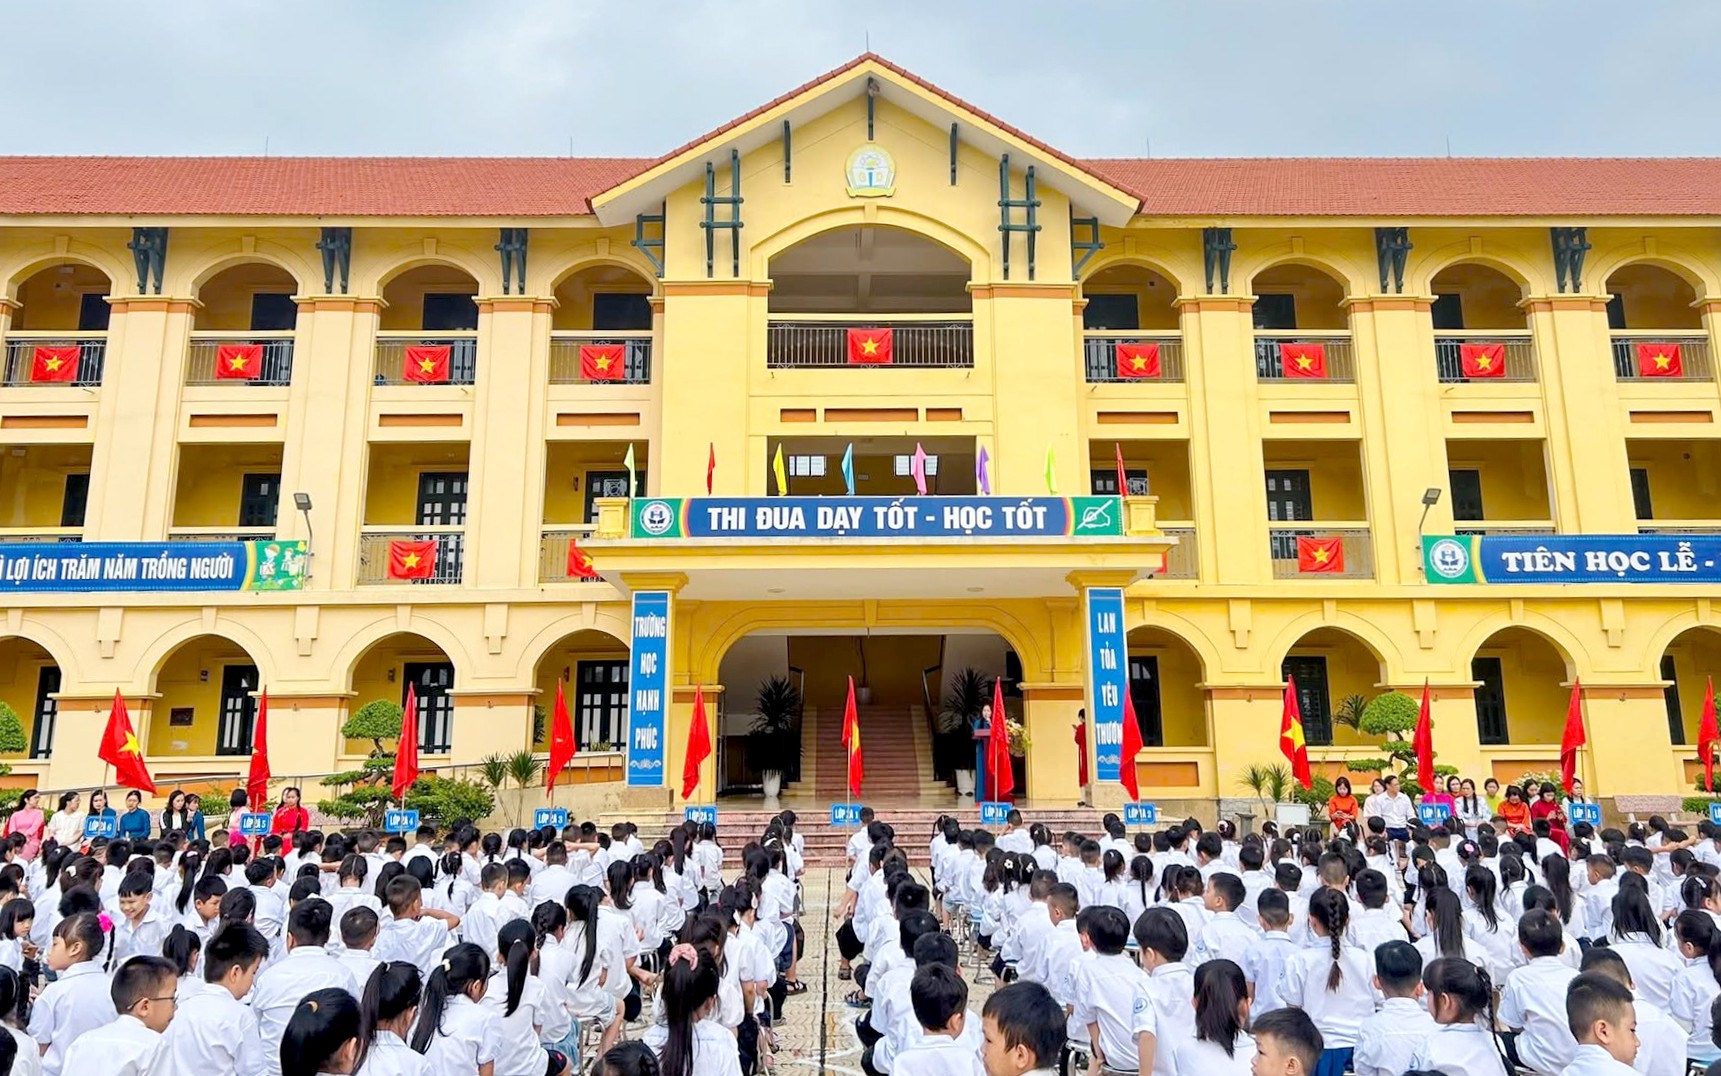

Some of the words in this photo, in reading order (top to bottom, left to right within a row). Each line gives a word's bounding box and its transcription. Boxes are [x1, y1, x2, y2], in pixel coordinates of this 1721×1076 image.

[707, 507, 746, 530] THI
[756, 507, 806, 530] ĐUA
[817, 507, 863, 535] DẠY
[873, 497, 918, 530] TỐT
[943, 506, 993, 534] HỌC
[1001, 497, 1047, 530] TỐT
[6, 556, 30, 585] LỢI
[32, 554, 58, 580] ÍCH
[61, 553, 101, 580] TRĂM
[103, 553, 138, 579] NĂM
[141, 550, 187, 580] TRỒNG
[190, 552, 234, 579] NGƯỜI
[1502, 545, 1576, 572] TIÊN
[1585, 551, 1650, 577] HỌC
[1657, 541, 1698, 571] LỄ
[635, 611, 666, 638] TRƯỜNG
[1097, 612, 1117, 633] LAN
[640, 652, 657, 678] HỌC
[1100, 640, 1117, 670] TỎA
[636, 689, 660, 715] HẠNH
[1101, 681, 1118, 707] YÊU
[634, 723, 658, 750] PHÚC
[1096, 720, 1123, 745] THƯƠN
